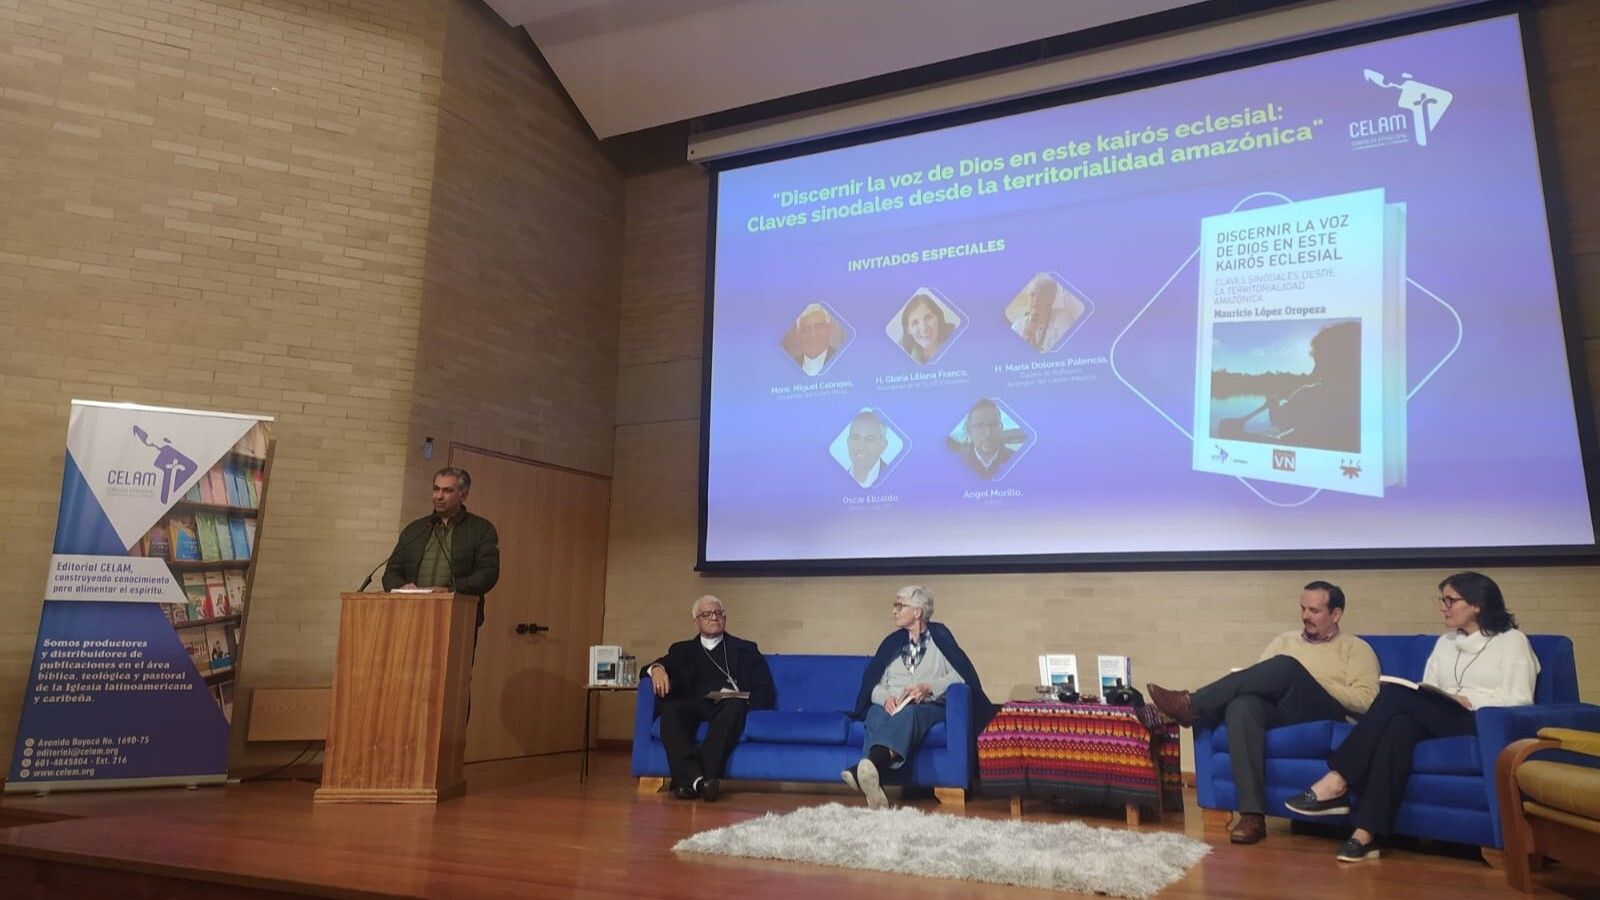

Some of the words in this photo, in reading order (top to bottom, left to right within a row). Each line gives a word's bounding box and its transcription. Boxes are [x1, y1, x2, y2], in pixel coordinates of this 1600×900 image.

[1349, 114, 1407, 138] CELAM
[773, 179, 863, 208] "Discernir
[867, 176, 885, 193] la
[890, 170, 923, 188] voz
[928, 164, 954, 182] de
[959, 156, 1005, 177] Dios
[1009, 151, 1037, 168] en
[1042, 139, 1092, 162] este
[1097, 126, 1169, 153] kairós
[1174, 103, 1283, 138] eclesial:
[747, 211, 807, 233] Claves
[811, 197, 904, 223] sinodales
[908, 184, 972, 207] desde
[977, 177, 998, 196] la
[1003, 147, 1165, 190] territorialidad
[1171, 119, 1324, 163] amazónica"
[1217, 223, 1291, 244] DISCERNIR
[1296, 219, 1315, 233] LA
[1319, 214, 1349, 230] VOZ
[1217, 245, 1233, 258] DE
[1237, 240, 1269, 256] DIOS
[1273, 237, 1293, 251] EN
[1298, 232, 1337, 249] ESTE
[848, 252, 919, 272] INVITADOS
[922, 239, 1005, 262] ESPECIALES
[1216, 256, 1265, 272] KAIRÓS
[1270, 248, 1343, 267] ECLESIAL
[1215, 275, 1247, 287] CLAVES
[1248, 271, 1299, 283] SINODALES
[1301, 268, 1336, 280] DESDE
[1227, 282, 1305, 295] TERRITORIALIDAD
[1214, 309, 1253, 319] Mauricio
[1254, 306, 1282, 318] López
[1285, 306, 1326, 316] Oropeza
[1031, 360, 1066, 370] Dolores
[1274, 455, 1295, 469] VN
[107, 469, 157, 486] CELAM
[57, 562, 97, 572] Editorial
[100, 563, 133, 574] CELAM,
[54, 574, 112, 584] construyendo
[114, 575, 169, 585] conocimiento
[53, 585, 73, 593] para
[75, 584, 116, 593] alimentar
[120, 584, 128, 593] el
[43, 639, 80, 648] Somos
[83, 639, 148, 649] productores
[41, 651, 48, 659] y
[50, 649, 127, 658] distribuidores
[129, 650, 143, 658] de
[39, 660, 116, 670] publicaciones
[134, 660, 144, 669] el
[146, 660, 170, 669] área
[81, 671, 131, 681] teológica
[133, 673, 139, 681] y
[142, 671, 186, 681] pastoral
[35, 683, 48, 692] de
[52, 683, 62, 691] la
[66, 683, 101, 692] Iglesia
[105, 682, 193, 691] latinoamericana
[33, 695, 40, 704] y
[38, 738, 70, 747] Avenida
[36, 747, 119, 757] editorial@celam.org
[33, 768, 95, 777] www.celam.org
